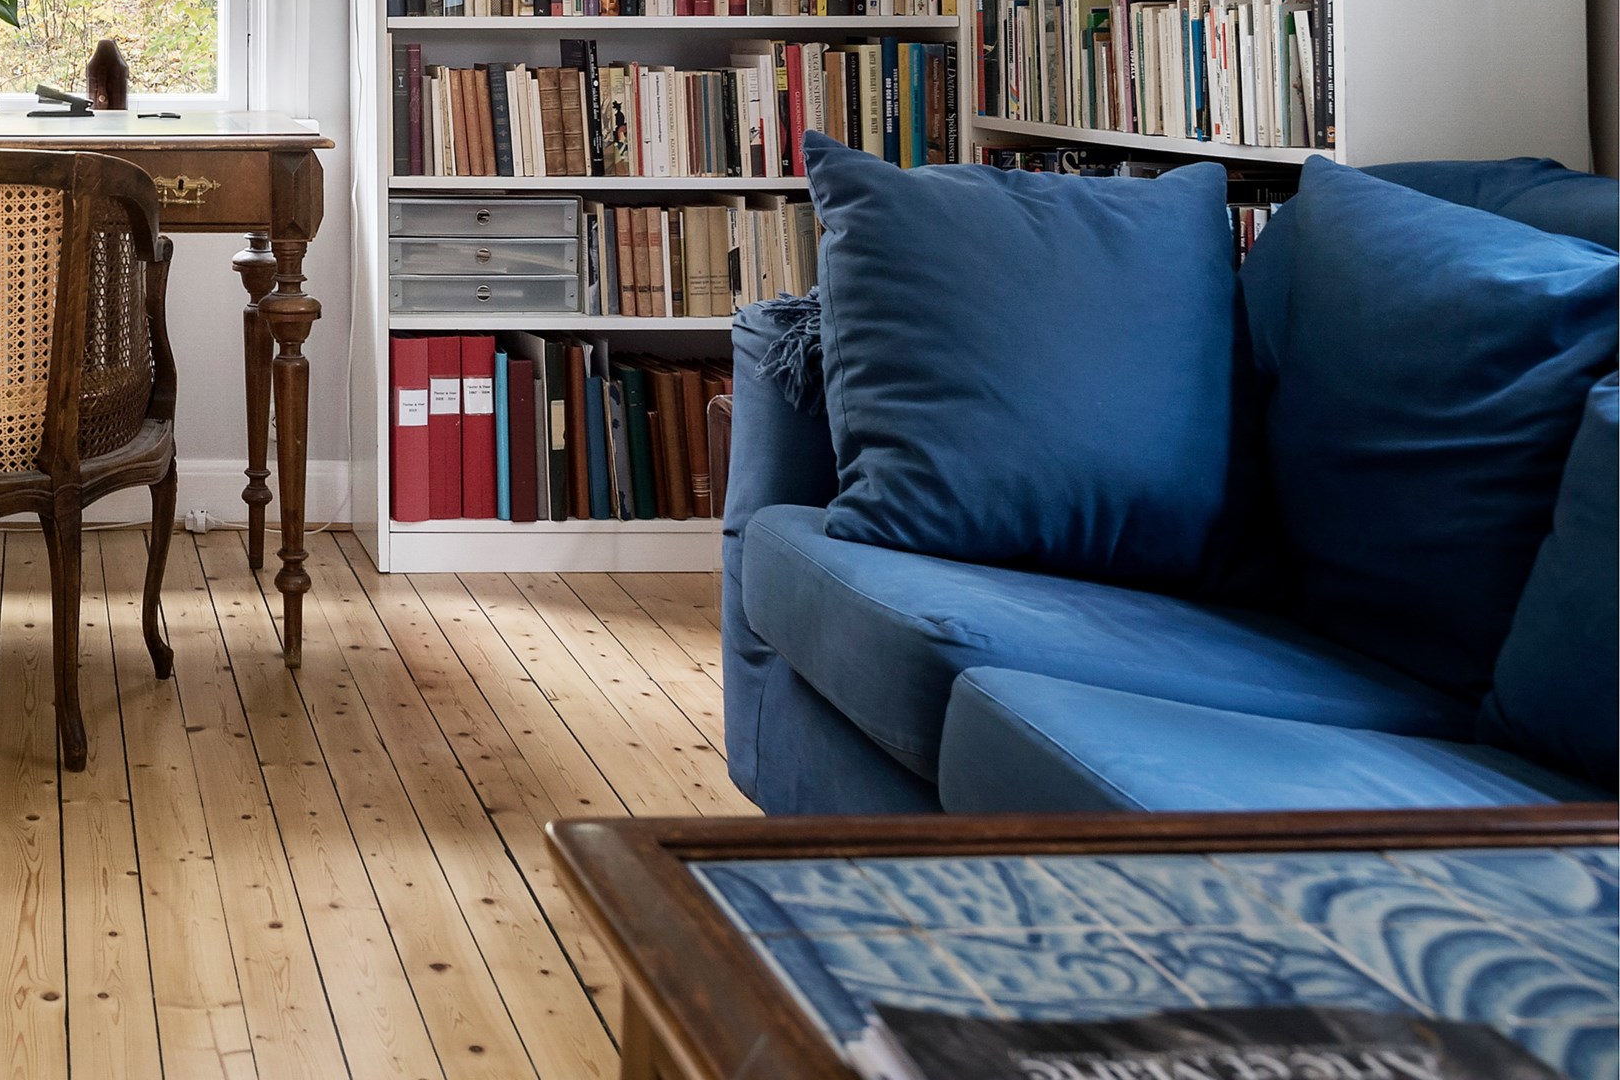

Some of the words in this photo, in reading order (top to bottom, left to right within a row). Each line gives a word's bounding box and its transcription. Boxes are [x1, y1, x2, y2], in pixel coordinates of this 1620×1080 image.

[814, 85, 822, 133] STRINDBER
[947, 68, 956, 109] Doctorow
[946, 113, 957, 162] Spökbussen
